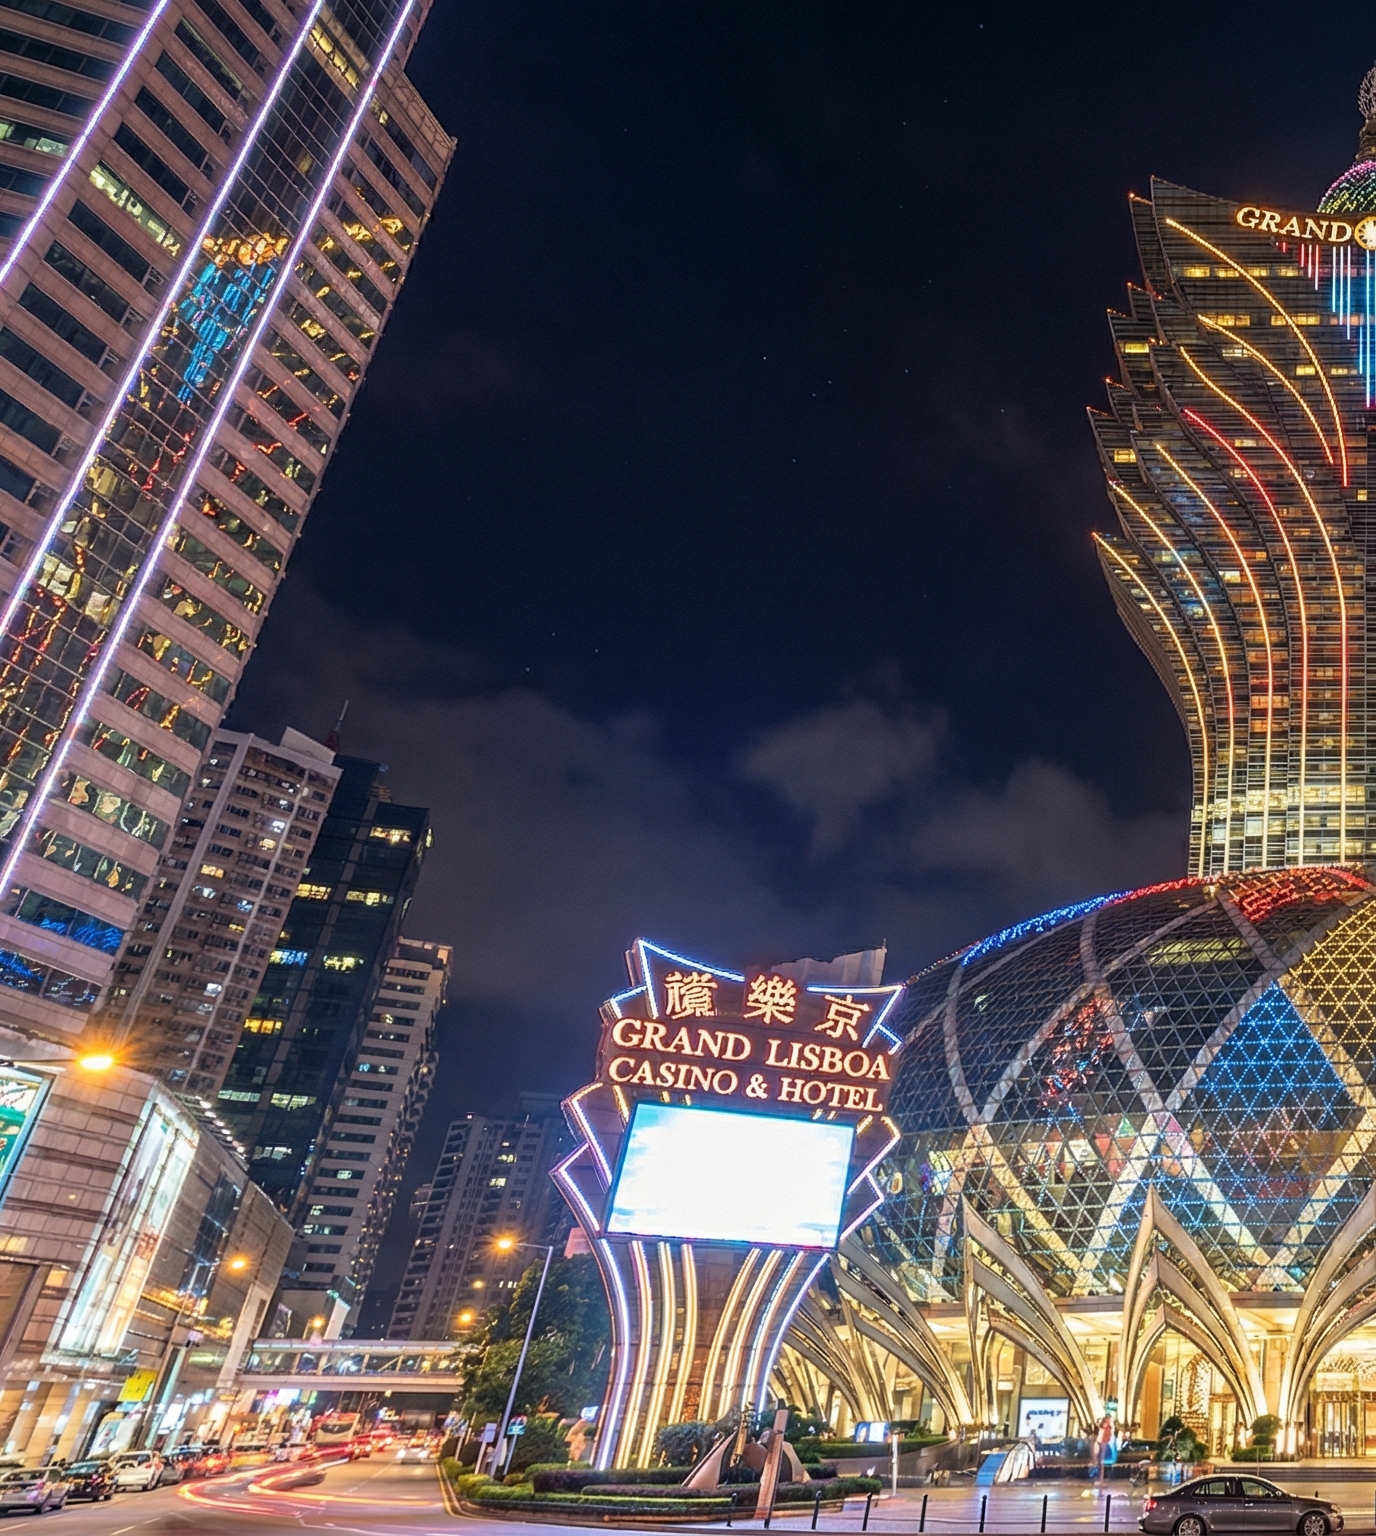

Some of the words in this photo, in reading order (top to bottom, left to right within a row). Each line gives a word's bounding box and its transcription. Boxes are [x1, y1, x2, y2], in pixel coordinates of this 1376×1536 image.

[1236, 207, 1351, 243] GRAND
[612, 1018, 750, 1061] GRAND
[765, 1039, 890, 1080] LISBOA
[608, 1056, 738, 1095] CASINO
[745, 1074, 769, 1098] &
[778, 1077, 883, 1111] HOTEL
